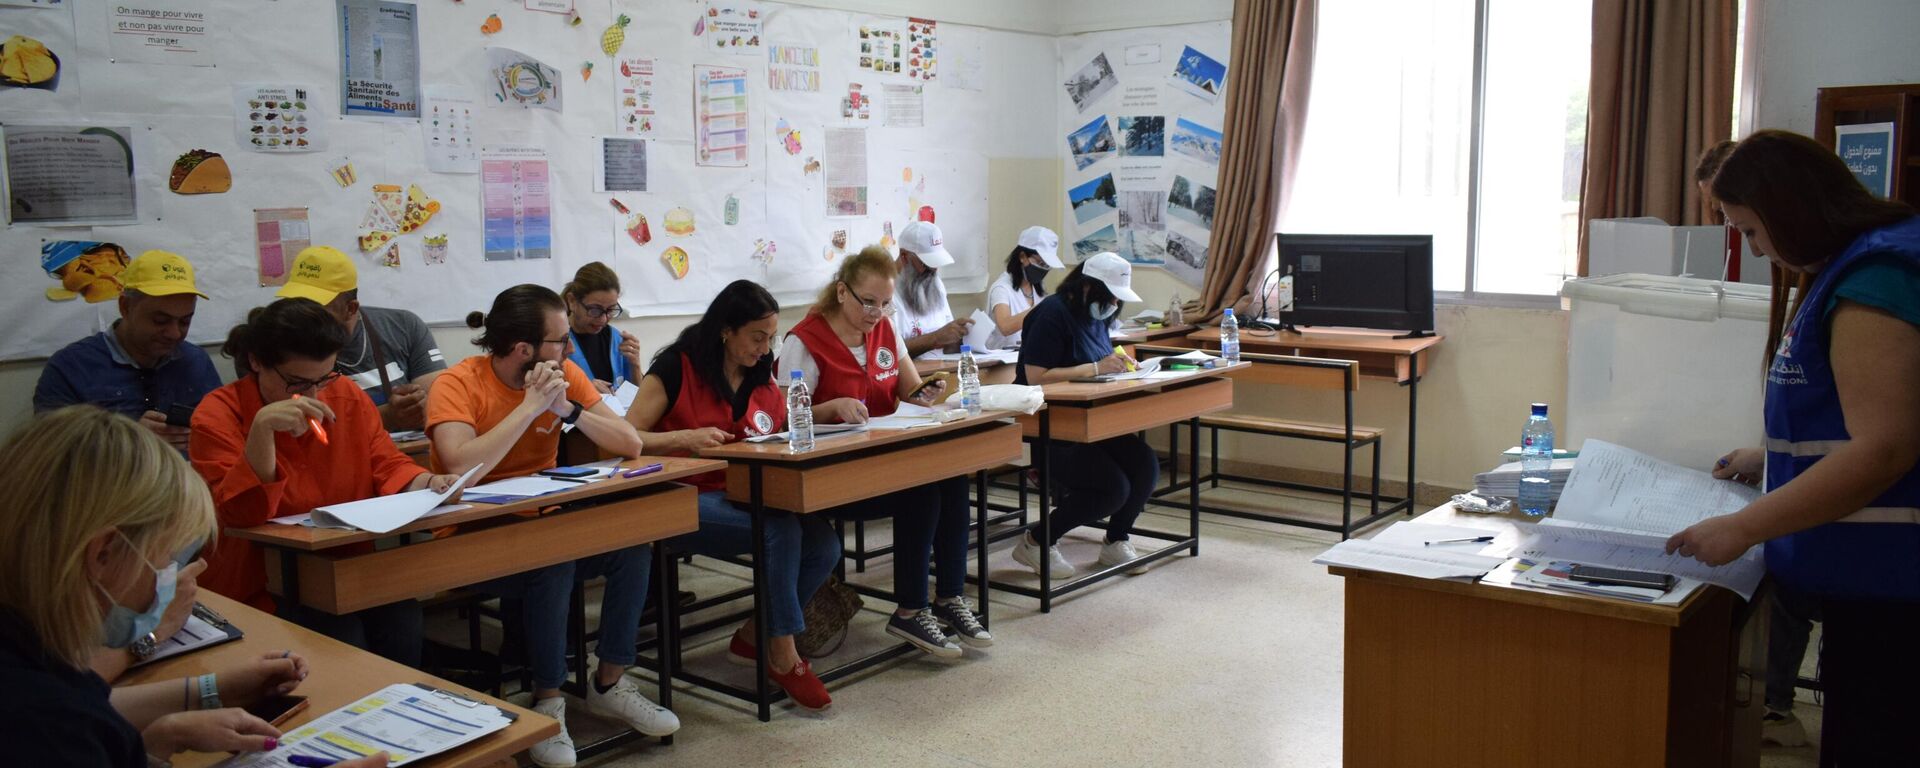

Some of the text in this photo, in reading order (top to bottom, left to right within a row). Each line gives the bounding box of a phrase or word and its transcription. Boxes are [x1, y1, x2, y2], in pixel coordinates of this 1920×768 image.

[117, 6, 204, 19] On mange pour vivre
[118, 21, 127, 29] et
[147, 23, 162, 31] pas
[163, 23, 184, 31] vivre
[185, 25, 205, 33] pour
[147, 36, 179, 45] manger
[348, 79, 393, 90] La Sécurité
[348, 86, 400, 97] Sanitaire des
[348, 92, 383, 102] Aliments
[383, 99, 416, 111] Santé
[1843, 144, 1882, 160] ممنوع الدخول
[1862, 163, 1878, 176] بدون
